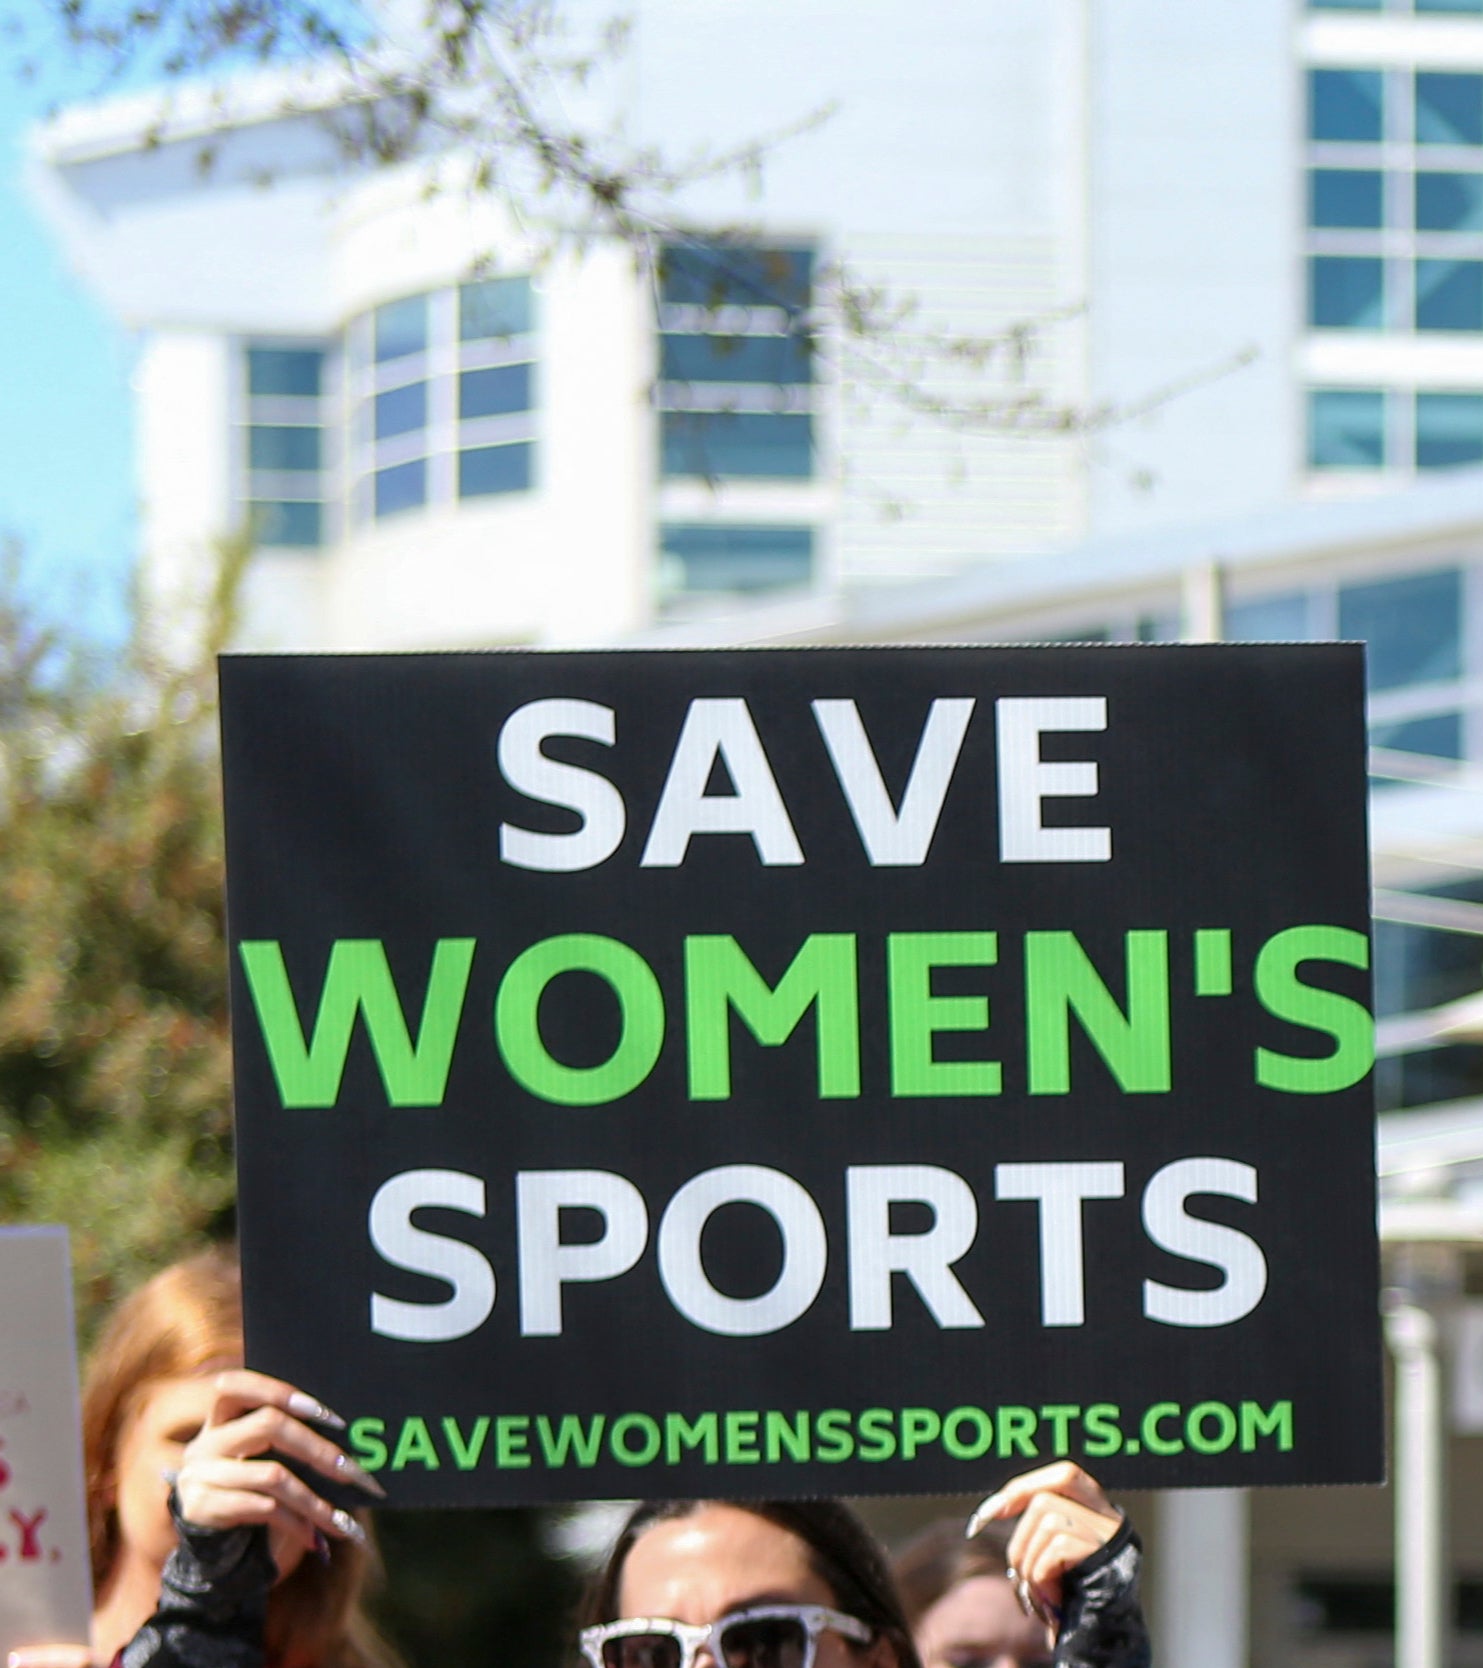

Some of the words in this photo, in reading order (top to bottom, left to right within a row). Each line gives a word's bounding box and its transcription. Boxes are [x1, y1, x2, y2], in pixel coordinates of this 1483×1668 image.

[499, 698, 1111, 871] SAVE
[239, 924, 1377, 1109] WOMEN'S
[370, 1158, 1266, 1340] SPORTS
[349, 1400, 1294, 1472] SAVEWOMENSSPORTS.COM
